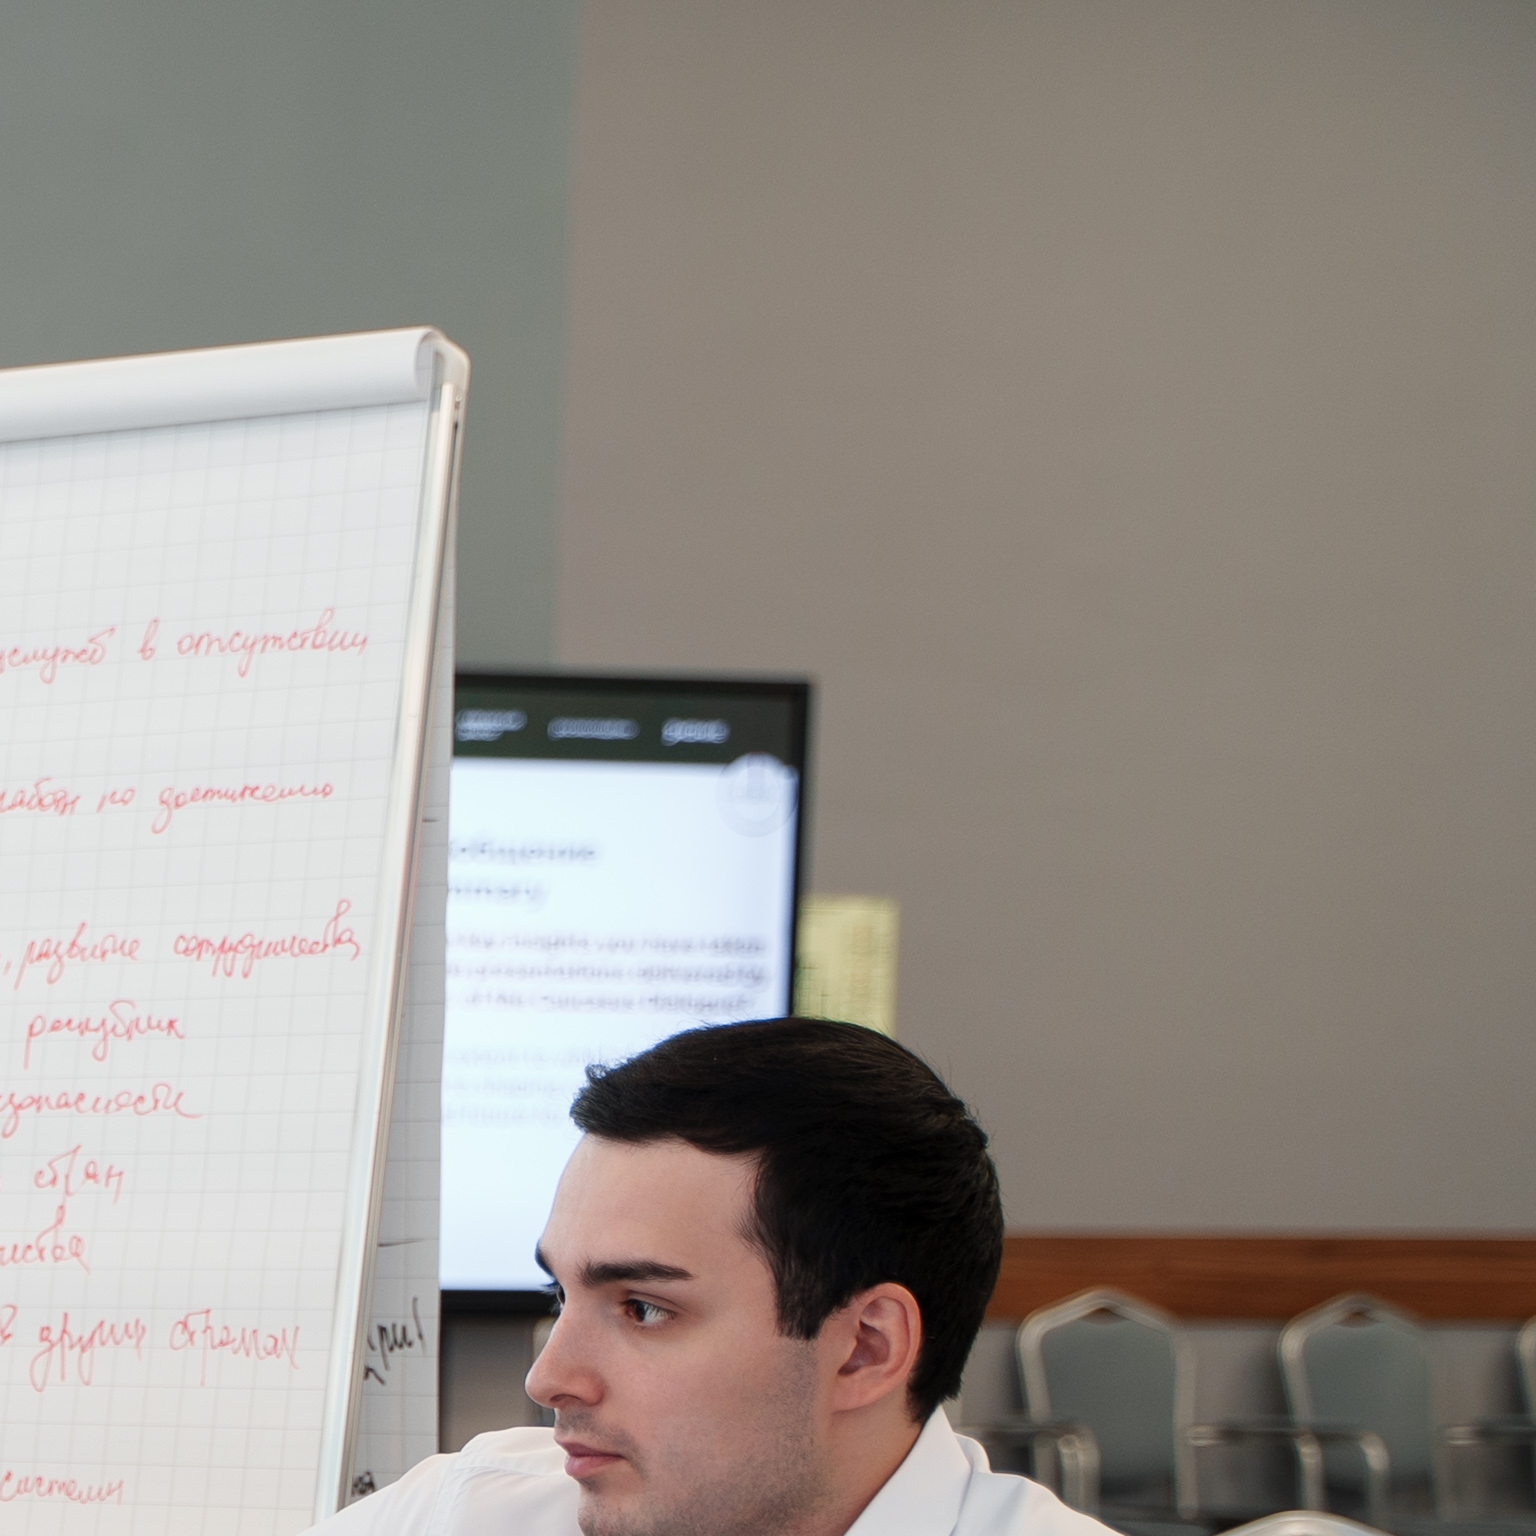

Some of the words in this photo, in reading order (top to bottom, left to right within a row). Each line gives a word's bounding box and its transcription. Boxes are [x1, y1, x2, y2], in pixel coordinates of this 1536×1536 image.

[137, 618, 160, 661] в
[96, 787, 135, 813] по
[151, 783, 334, 834] достижению
[14, 921, 141, 991] развитие
[24, 998, 186, 1071] республик
[33, 1144, 125, 1205] стран
